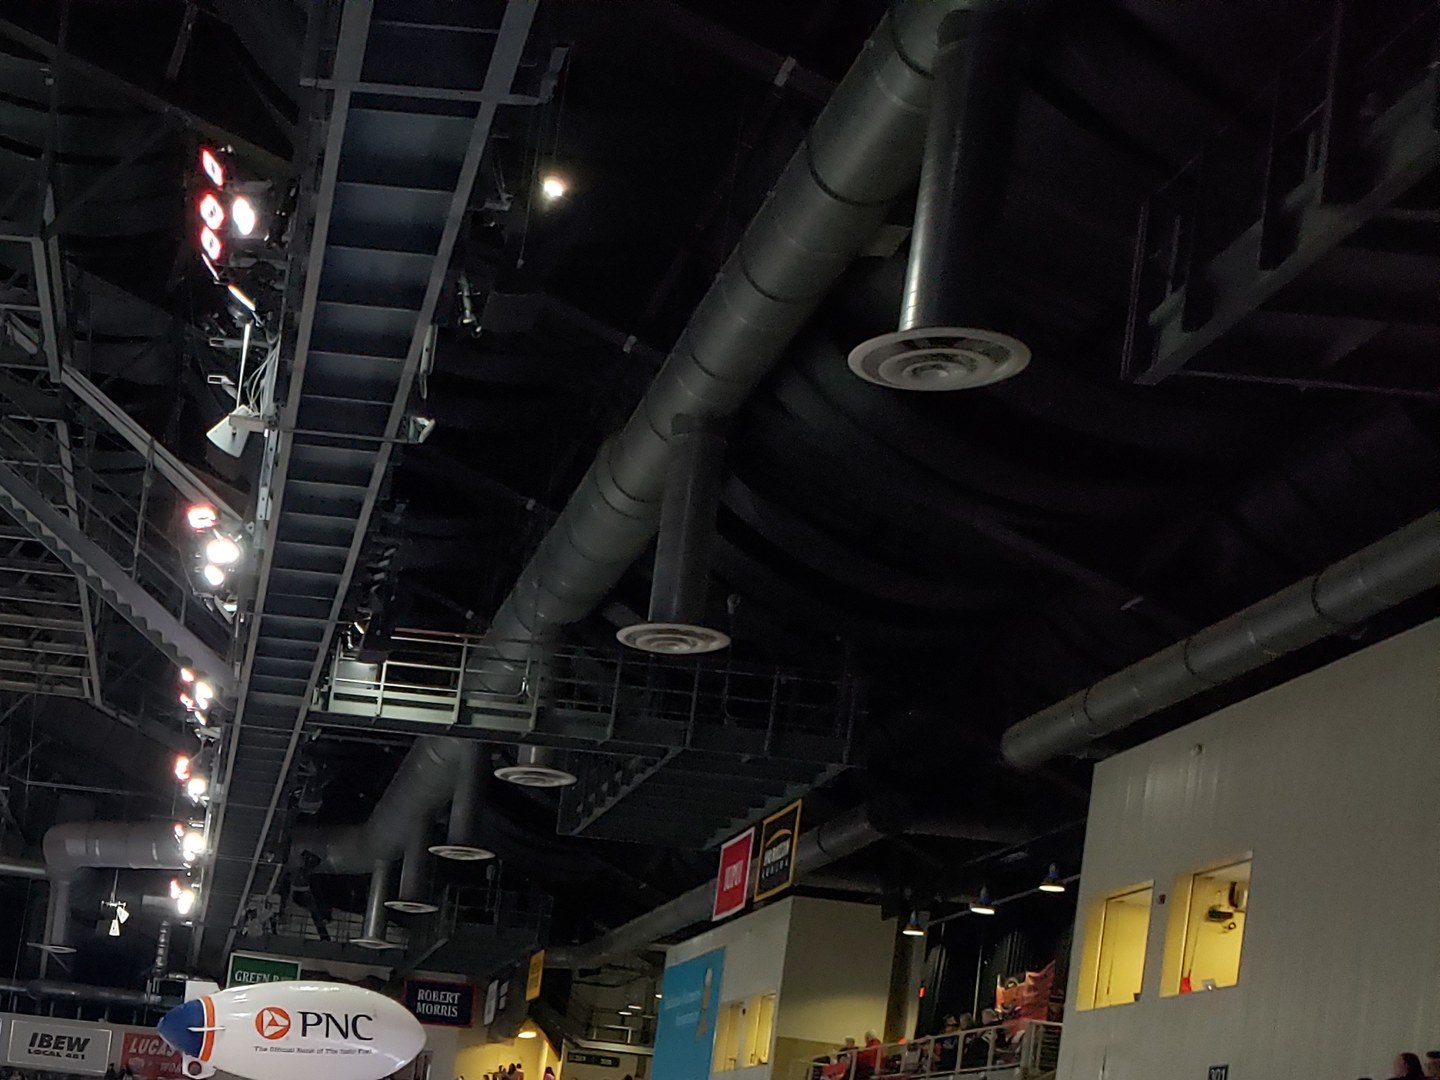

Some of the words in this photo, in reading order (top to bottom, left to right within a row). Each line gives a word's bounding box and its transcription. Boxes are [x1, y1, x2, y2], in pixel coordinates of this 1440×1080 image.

[234, 970, 271, 984] GREEN
[417, 988, 461, 1005] ROBERT
[416, 1001, 459, 1018] MORRIS
[298, 1010, 375, 1042] PNC
[28, 1031, 91, 1052] IBEW
[27, 1049, 63, 1060] LOCAL
